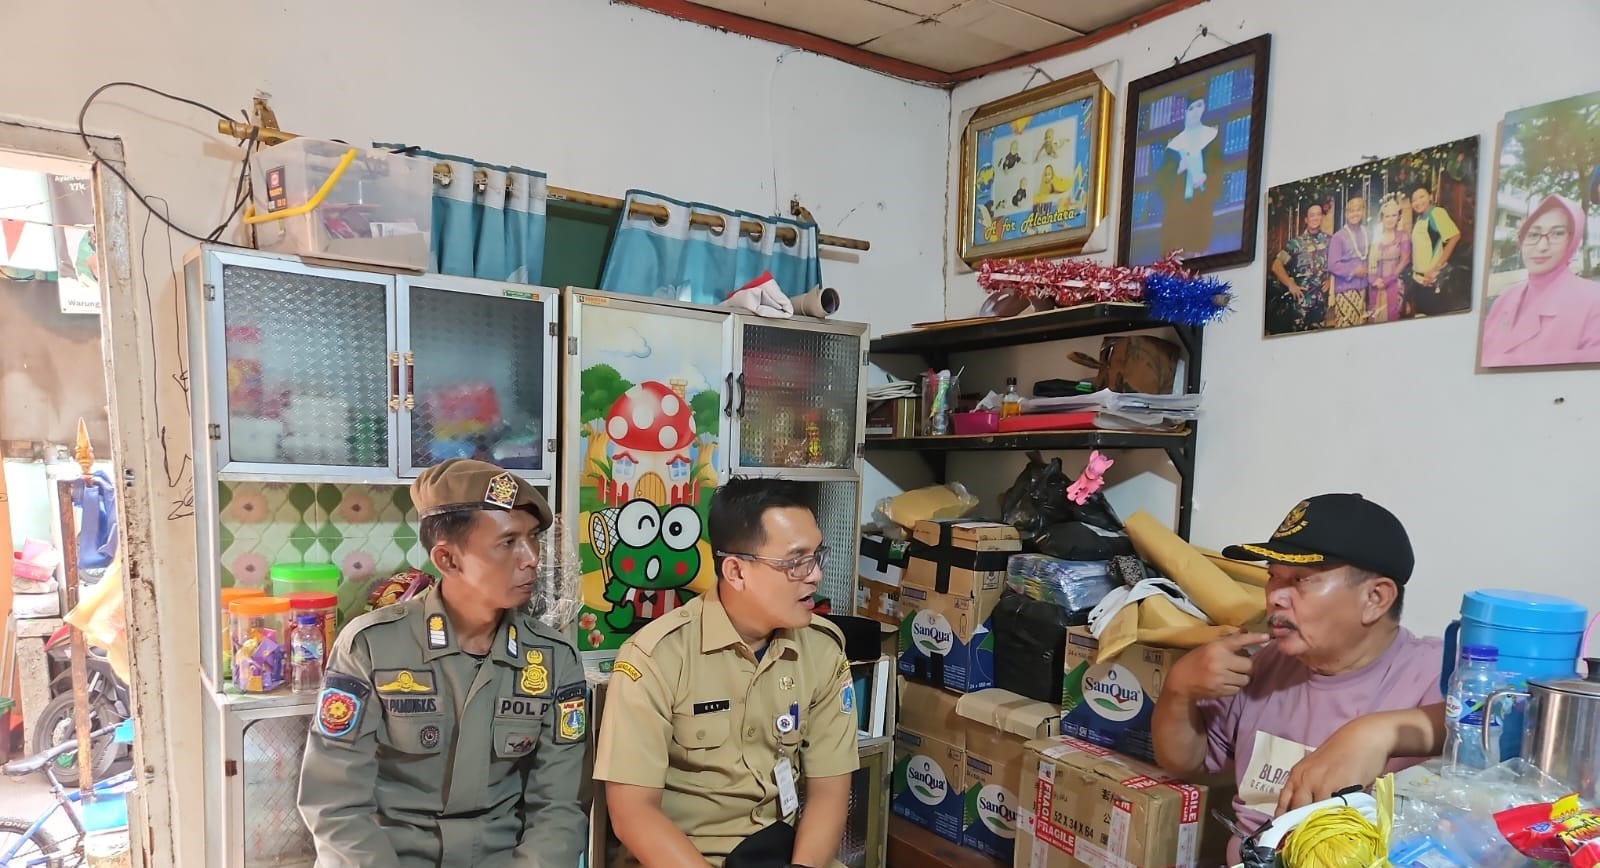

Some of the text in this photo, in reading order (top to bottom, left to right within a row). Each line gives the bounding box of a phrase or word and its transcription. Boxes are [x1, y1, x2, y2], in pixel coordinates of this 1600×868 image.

[1021, 208, 1075, 233] Alcantara
[913, 622, 950, 644] SanQua
[1084, 676, 1138, 703] SanQua
[500, 700, 535, 716] POL
[540, 703, 549, 716] P
[908, 767, 945, 790] SanQua
[979, 796, 1018, 822] SanQu
[1041, 783, 1053, 822] FRAGI
[1038, 820, 1075, 847] FRAGILE
